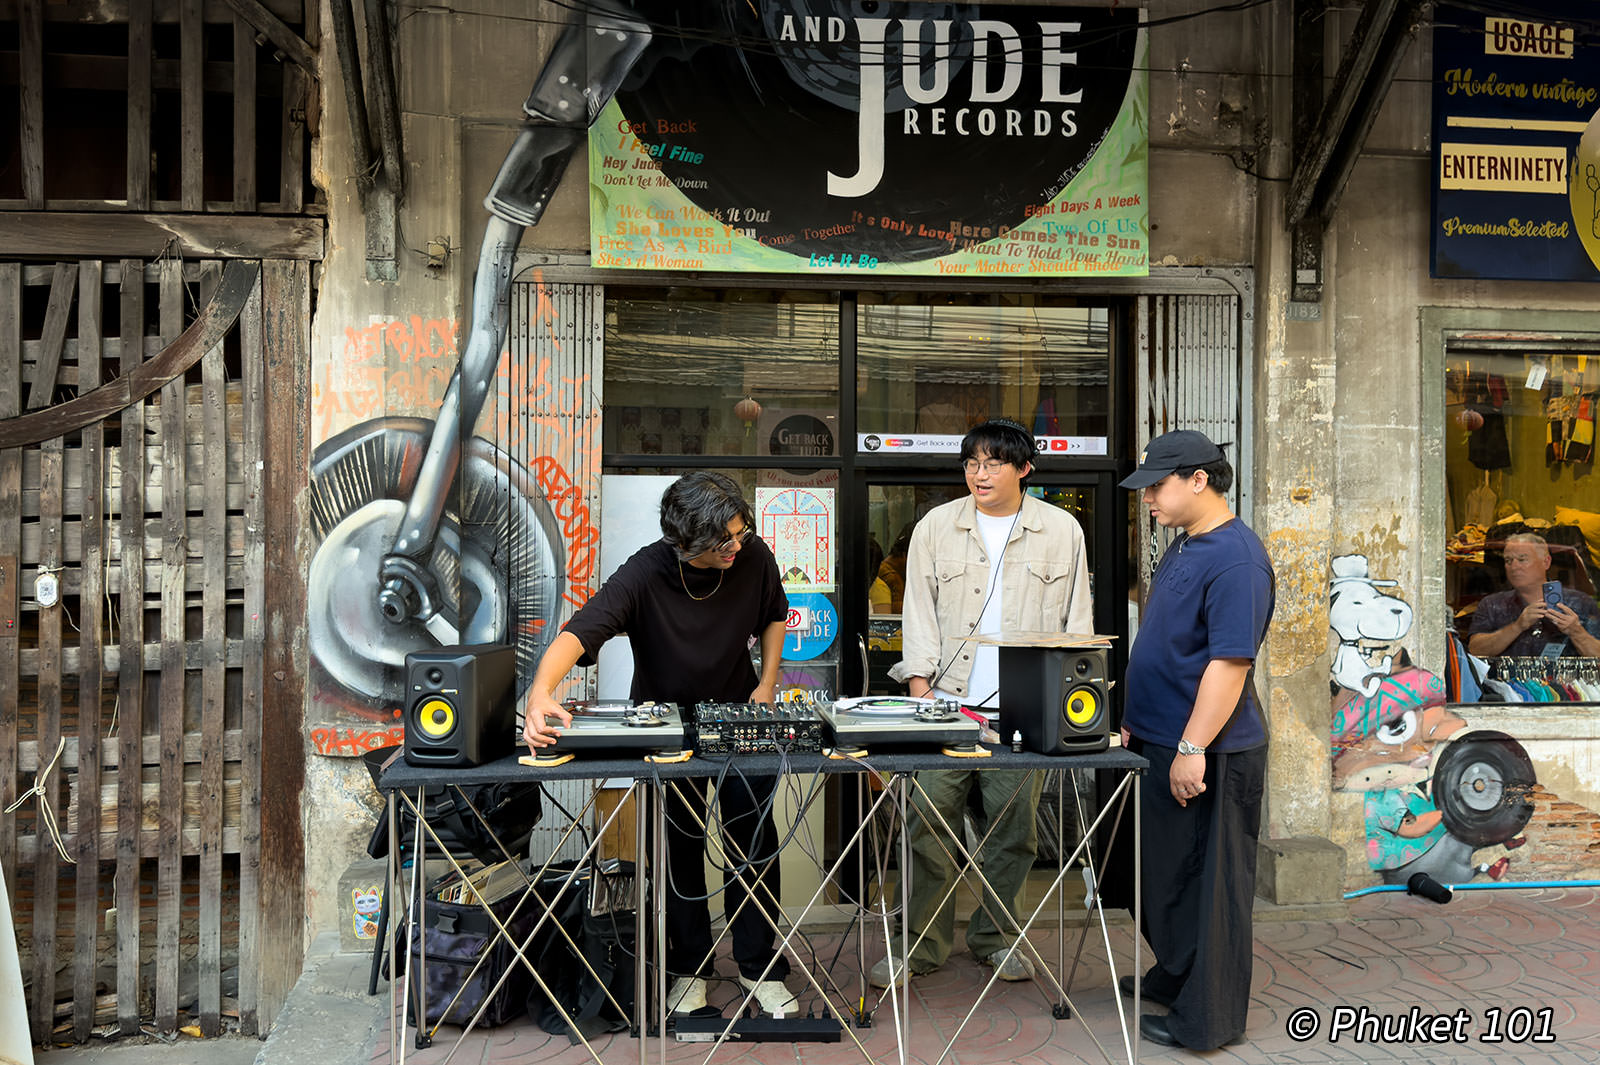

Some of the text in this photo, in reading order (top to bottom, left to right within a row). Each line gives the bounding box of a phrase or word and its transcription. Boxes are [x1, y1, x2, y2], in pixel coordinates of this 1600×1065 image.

[781, 15, 846, 42] AND
[1494, 21, 1566, 55] USAGE
[1444, 68, 1597, 108] Modern vintage
[827, 17, 1083, 198] JUDE
[618, 119, 697, 134] Get Back
[904, 108, 1077, 137] RECORDS
[618, 136, 705, 165] I Feel Fine
[603, 156, 663, 171] Hey Jude
[1443, 155, 1564, 182] ENTERNINETY
[602, 174, 708, 190] Don't Let Me Down
[616, 204, 771, 223] We Can Work It Out
[1025, 194, 1141, 218] Eight Days A Week
[616, 221, 756, 238] She Loves You
[758, 223, 857, 247] Come Together
[881, 216, 914, 236] Only
[918, 224, 955, 242] Love
[950, 221, 1140, 250] Here Comes The Sun
[1042, 219, 1139, 235] Two Of Us
[598, 235, 732, 254] Free As A Bird
[960, 239, 1002, 256] Want
[1005, 242, 1023, 257] To
[1026, 244, 1063, 260] Hold
[1066, 248, 1101, 263] Your
[1105, 250, 1146, 266] Hand
[597, 252, 703, 268] She's A Woman
[809, 253, 878, 269] Let It Be
[934, 259, 971, 273] Your
[975, 259, 1024, 273] Mother
[1028, 258, 1078, 273] Should
[1289, 306, 1319, 318] 1182
[810, 609, 832, 622] ACK
